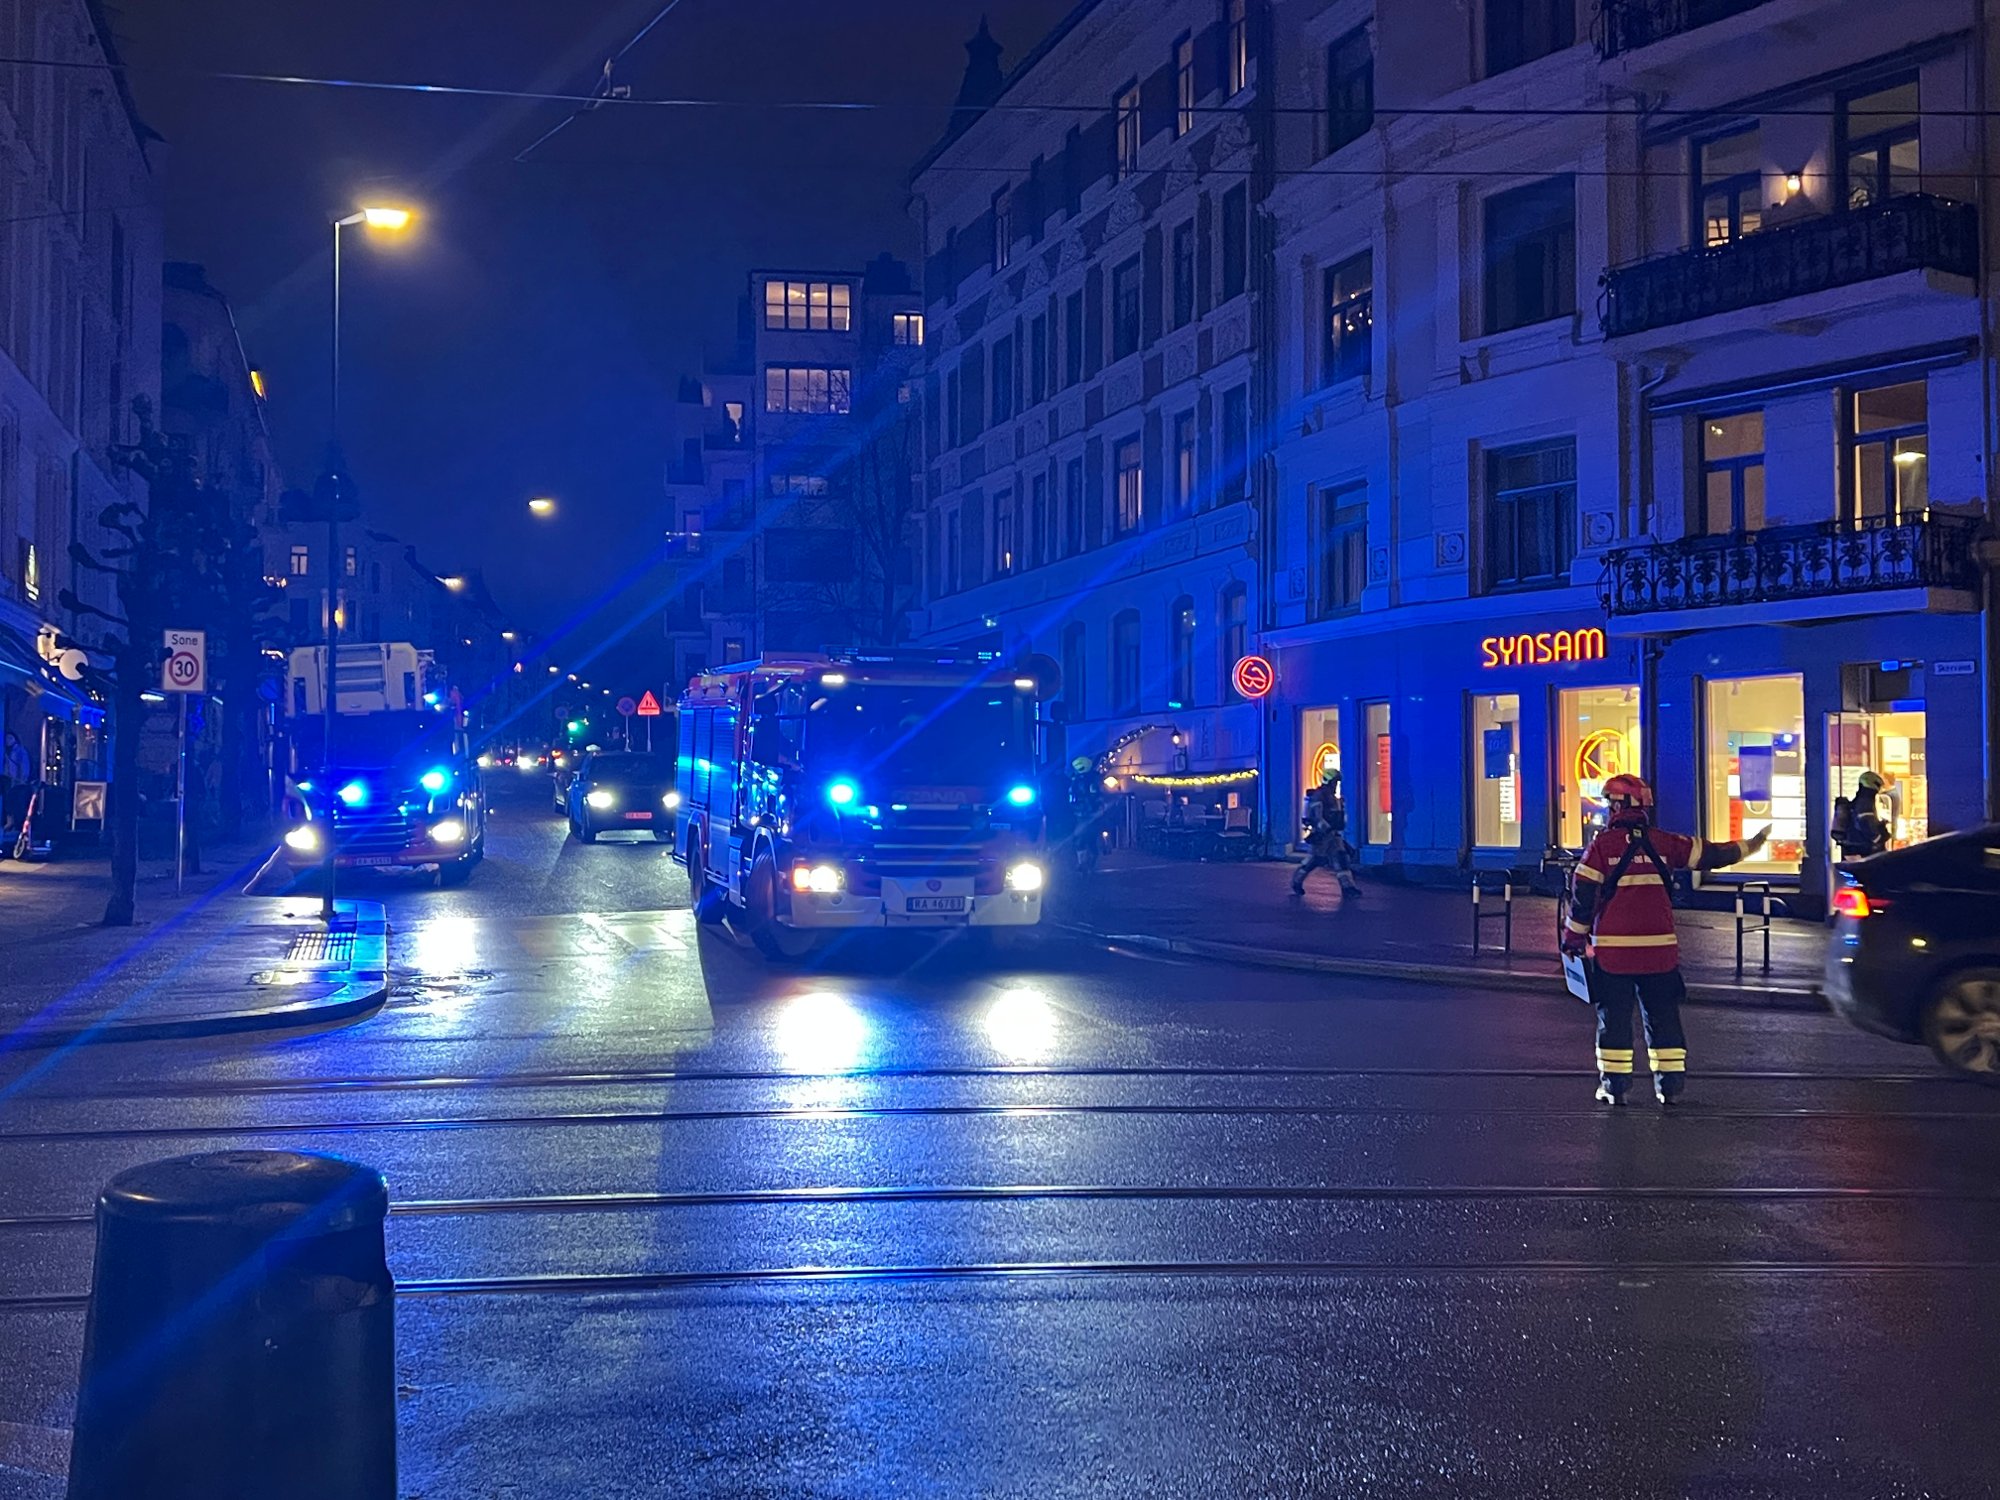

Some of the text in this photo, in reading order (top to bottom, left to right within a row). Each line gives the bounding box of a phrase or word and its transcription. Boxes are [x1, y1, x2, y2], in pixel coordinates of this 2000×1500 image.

[171, 634, 198, 646] Sone
[1481, 627, 1605, 667] SYNSAM
[175, 660, 194, 677] 30
